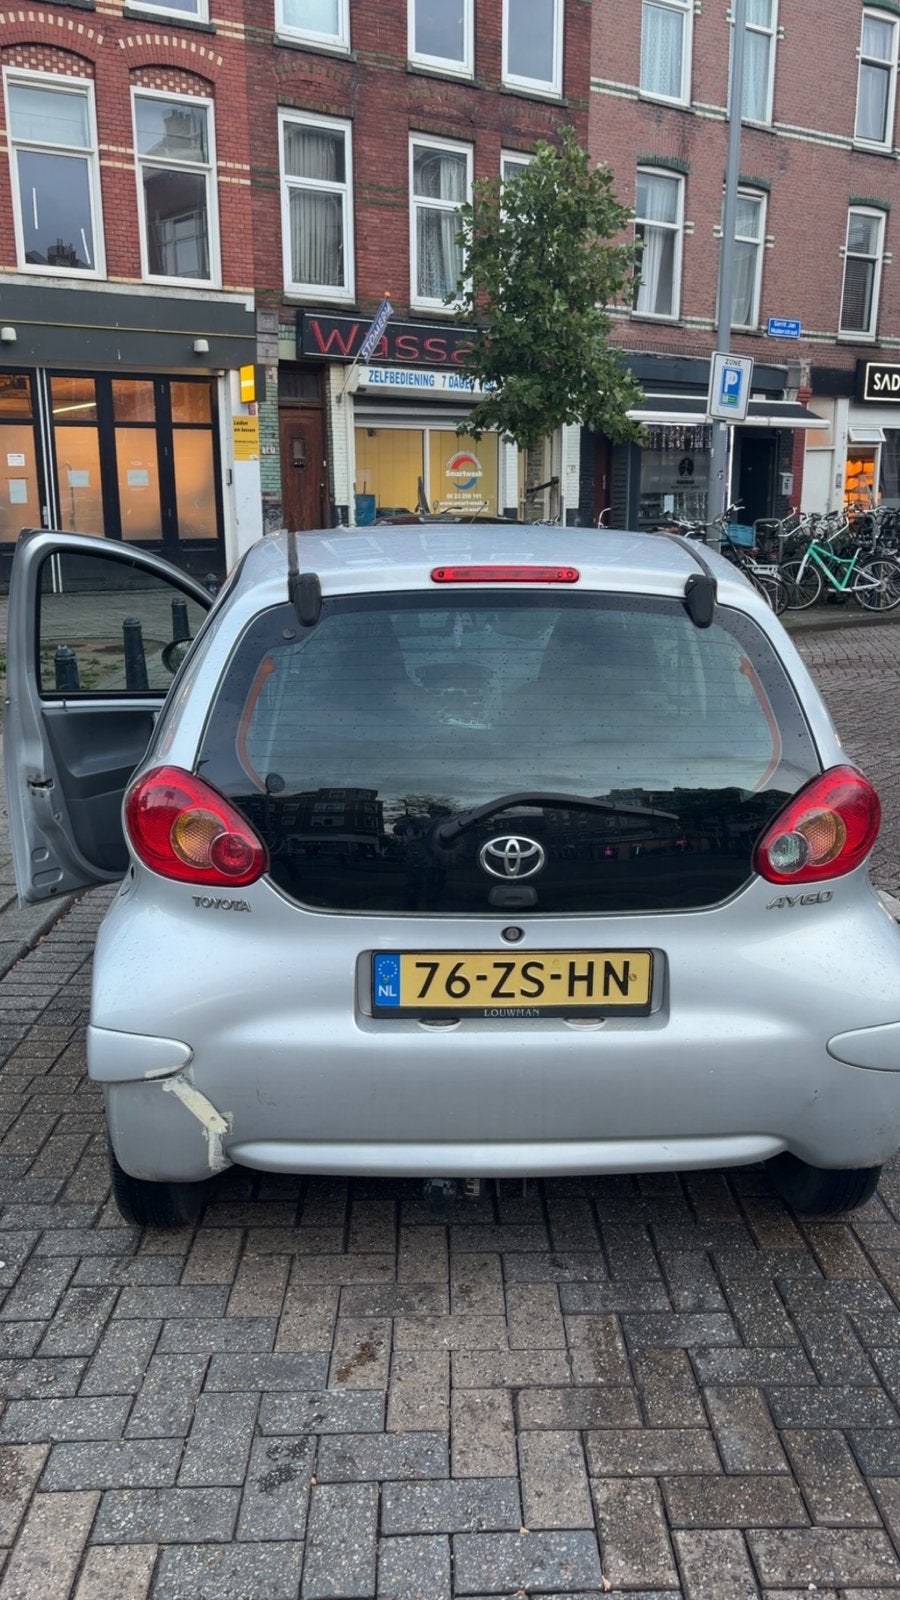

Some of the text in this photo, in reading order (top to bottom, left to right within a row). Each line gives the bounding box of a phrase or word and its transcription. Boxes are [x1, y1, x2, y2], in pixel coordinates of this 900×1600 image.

[725, 358, 742, 367] ZONE
[368, 369, 435, 387] ZELFBEDIENING
[442, 376, 447, 387] 7
[724, 370, 738, 393] P
[192, 895, 251, 912] TOYOTA
[766, 890, 834, 910] AYGO
[379, 960, 630, 999] NL 76-ZS-HN
[484, 1008, 540, 1017] LOUWMAN
